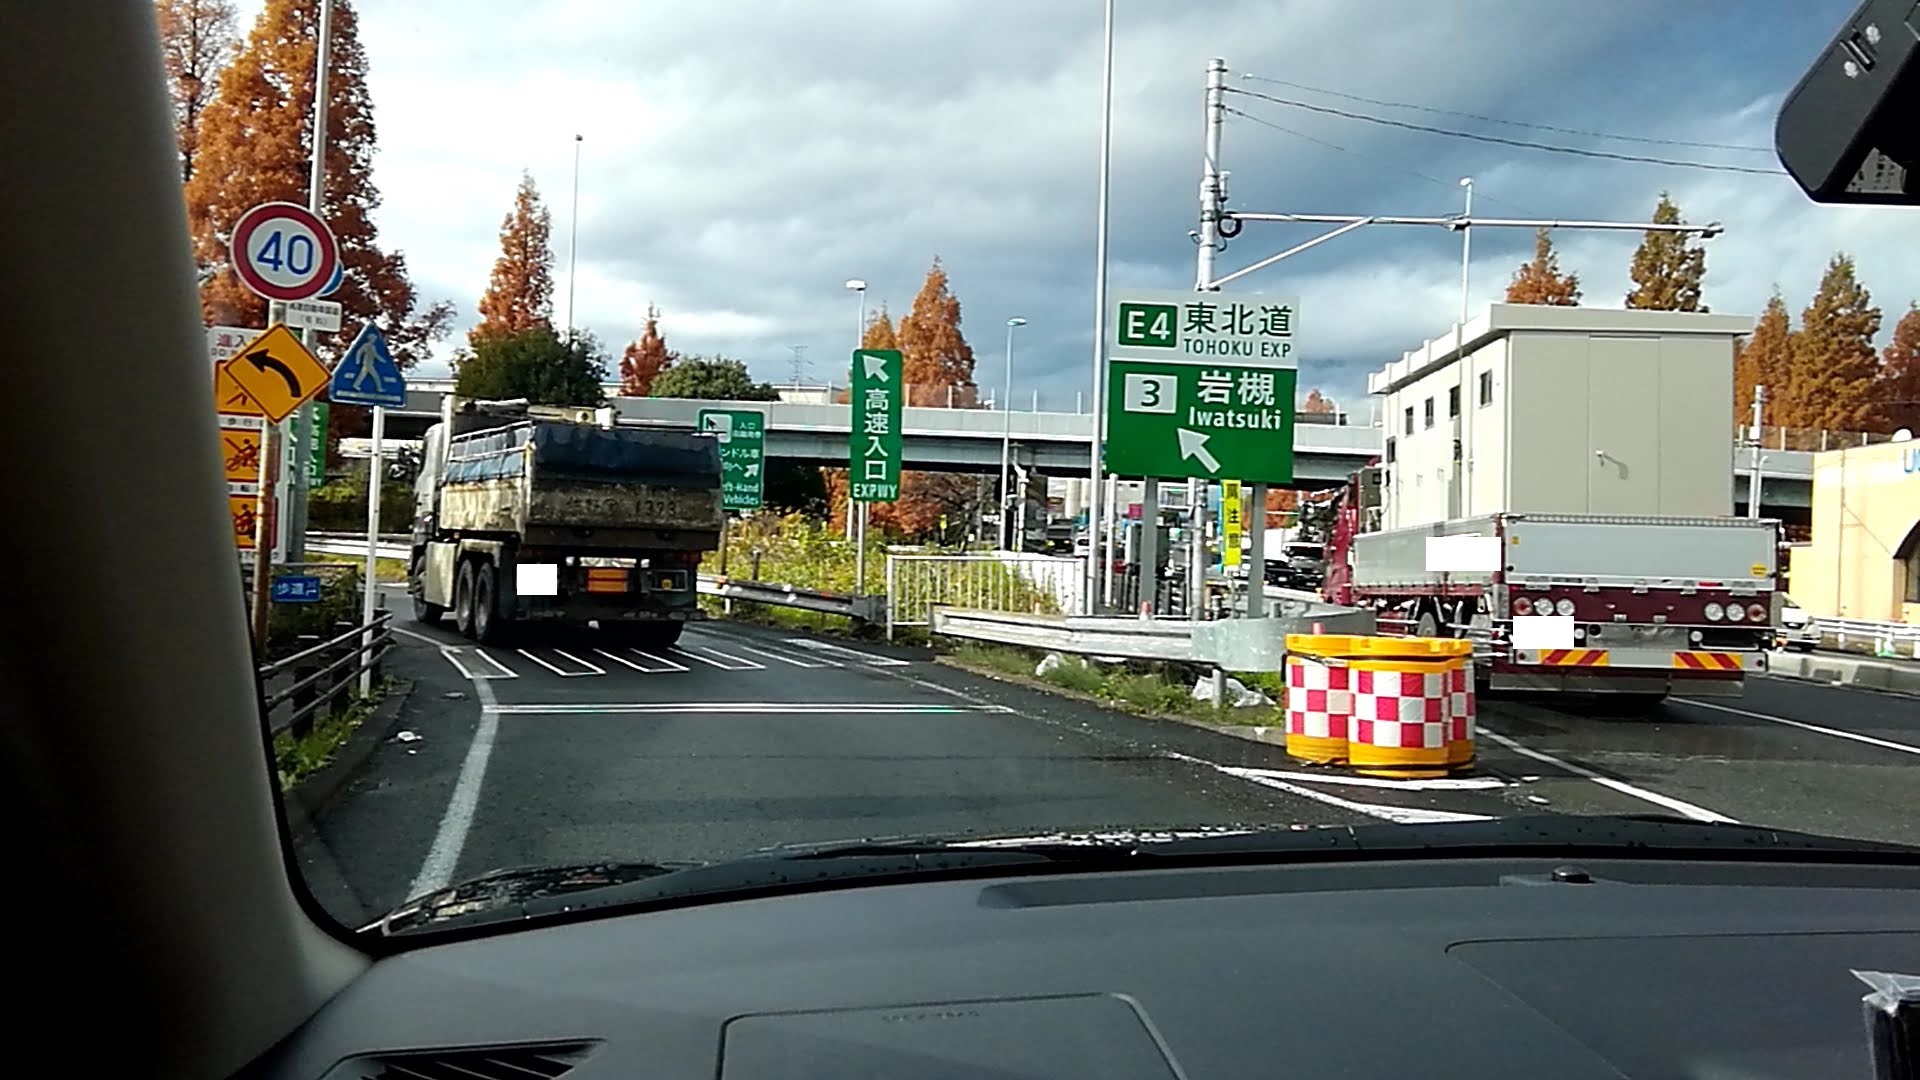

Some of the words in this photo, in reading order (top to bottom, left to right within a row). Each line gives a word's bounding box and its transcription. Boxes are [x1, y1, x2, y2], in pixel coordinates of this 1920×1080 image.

[256, 230, 314, 276] 40
[1126, 309, 1171, 341] E4
[1183, 301, 1293, 338] 東北道
[1183, 338, 1254, 357] TOHOKU
[1260, 341, 1292, 358] EXP
[1140, 379, 1161, 408] 3
[1196, 369, 1276, 407] 岩槻
[1187, 406, 1282, 430] Iwatsuki
[863, 387, 890, 481] 高速入口
[720, 447, 760, 459] ンドル車
[852, 482, 898, 499] EXPWY
